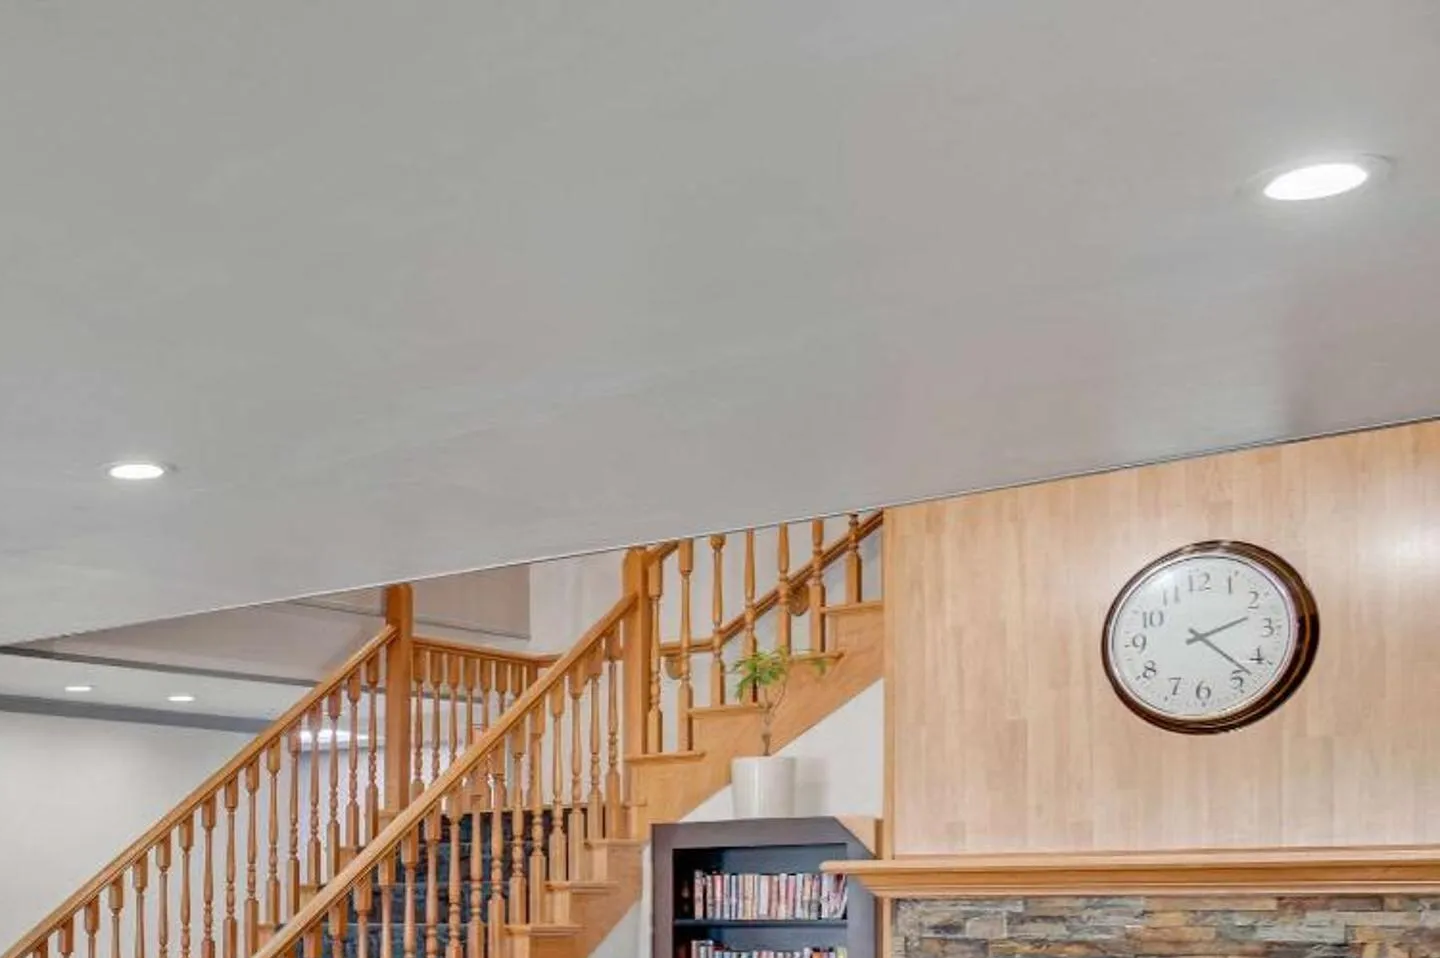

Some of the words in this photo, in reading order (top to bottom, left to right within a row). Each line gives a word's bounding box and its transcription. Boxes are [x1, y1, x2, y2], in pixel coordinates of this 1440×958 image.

[1188, 571, 1211, 592] 12
[1247, 590, 1259, 609] 2
[1142, 610, 1164, 629] 10
[1260, 617, 1274, 637] 3
[1132, 633, 1147, 654] 9
[1249, 646, 1264, 664] 4
[1142, 660, 1156, 679] 8
[1168, 677, 1182, 696] 7
[1195, 680, 1212, 700] 6
